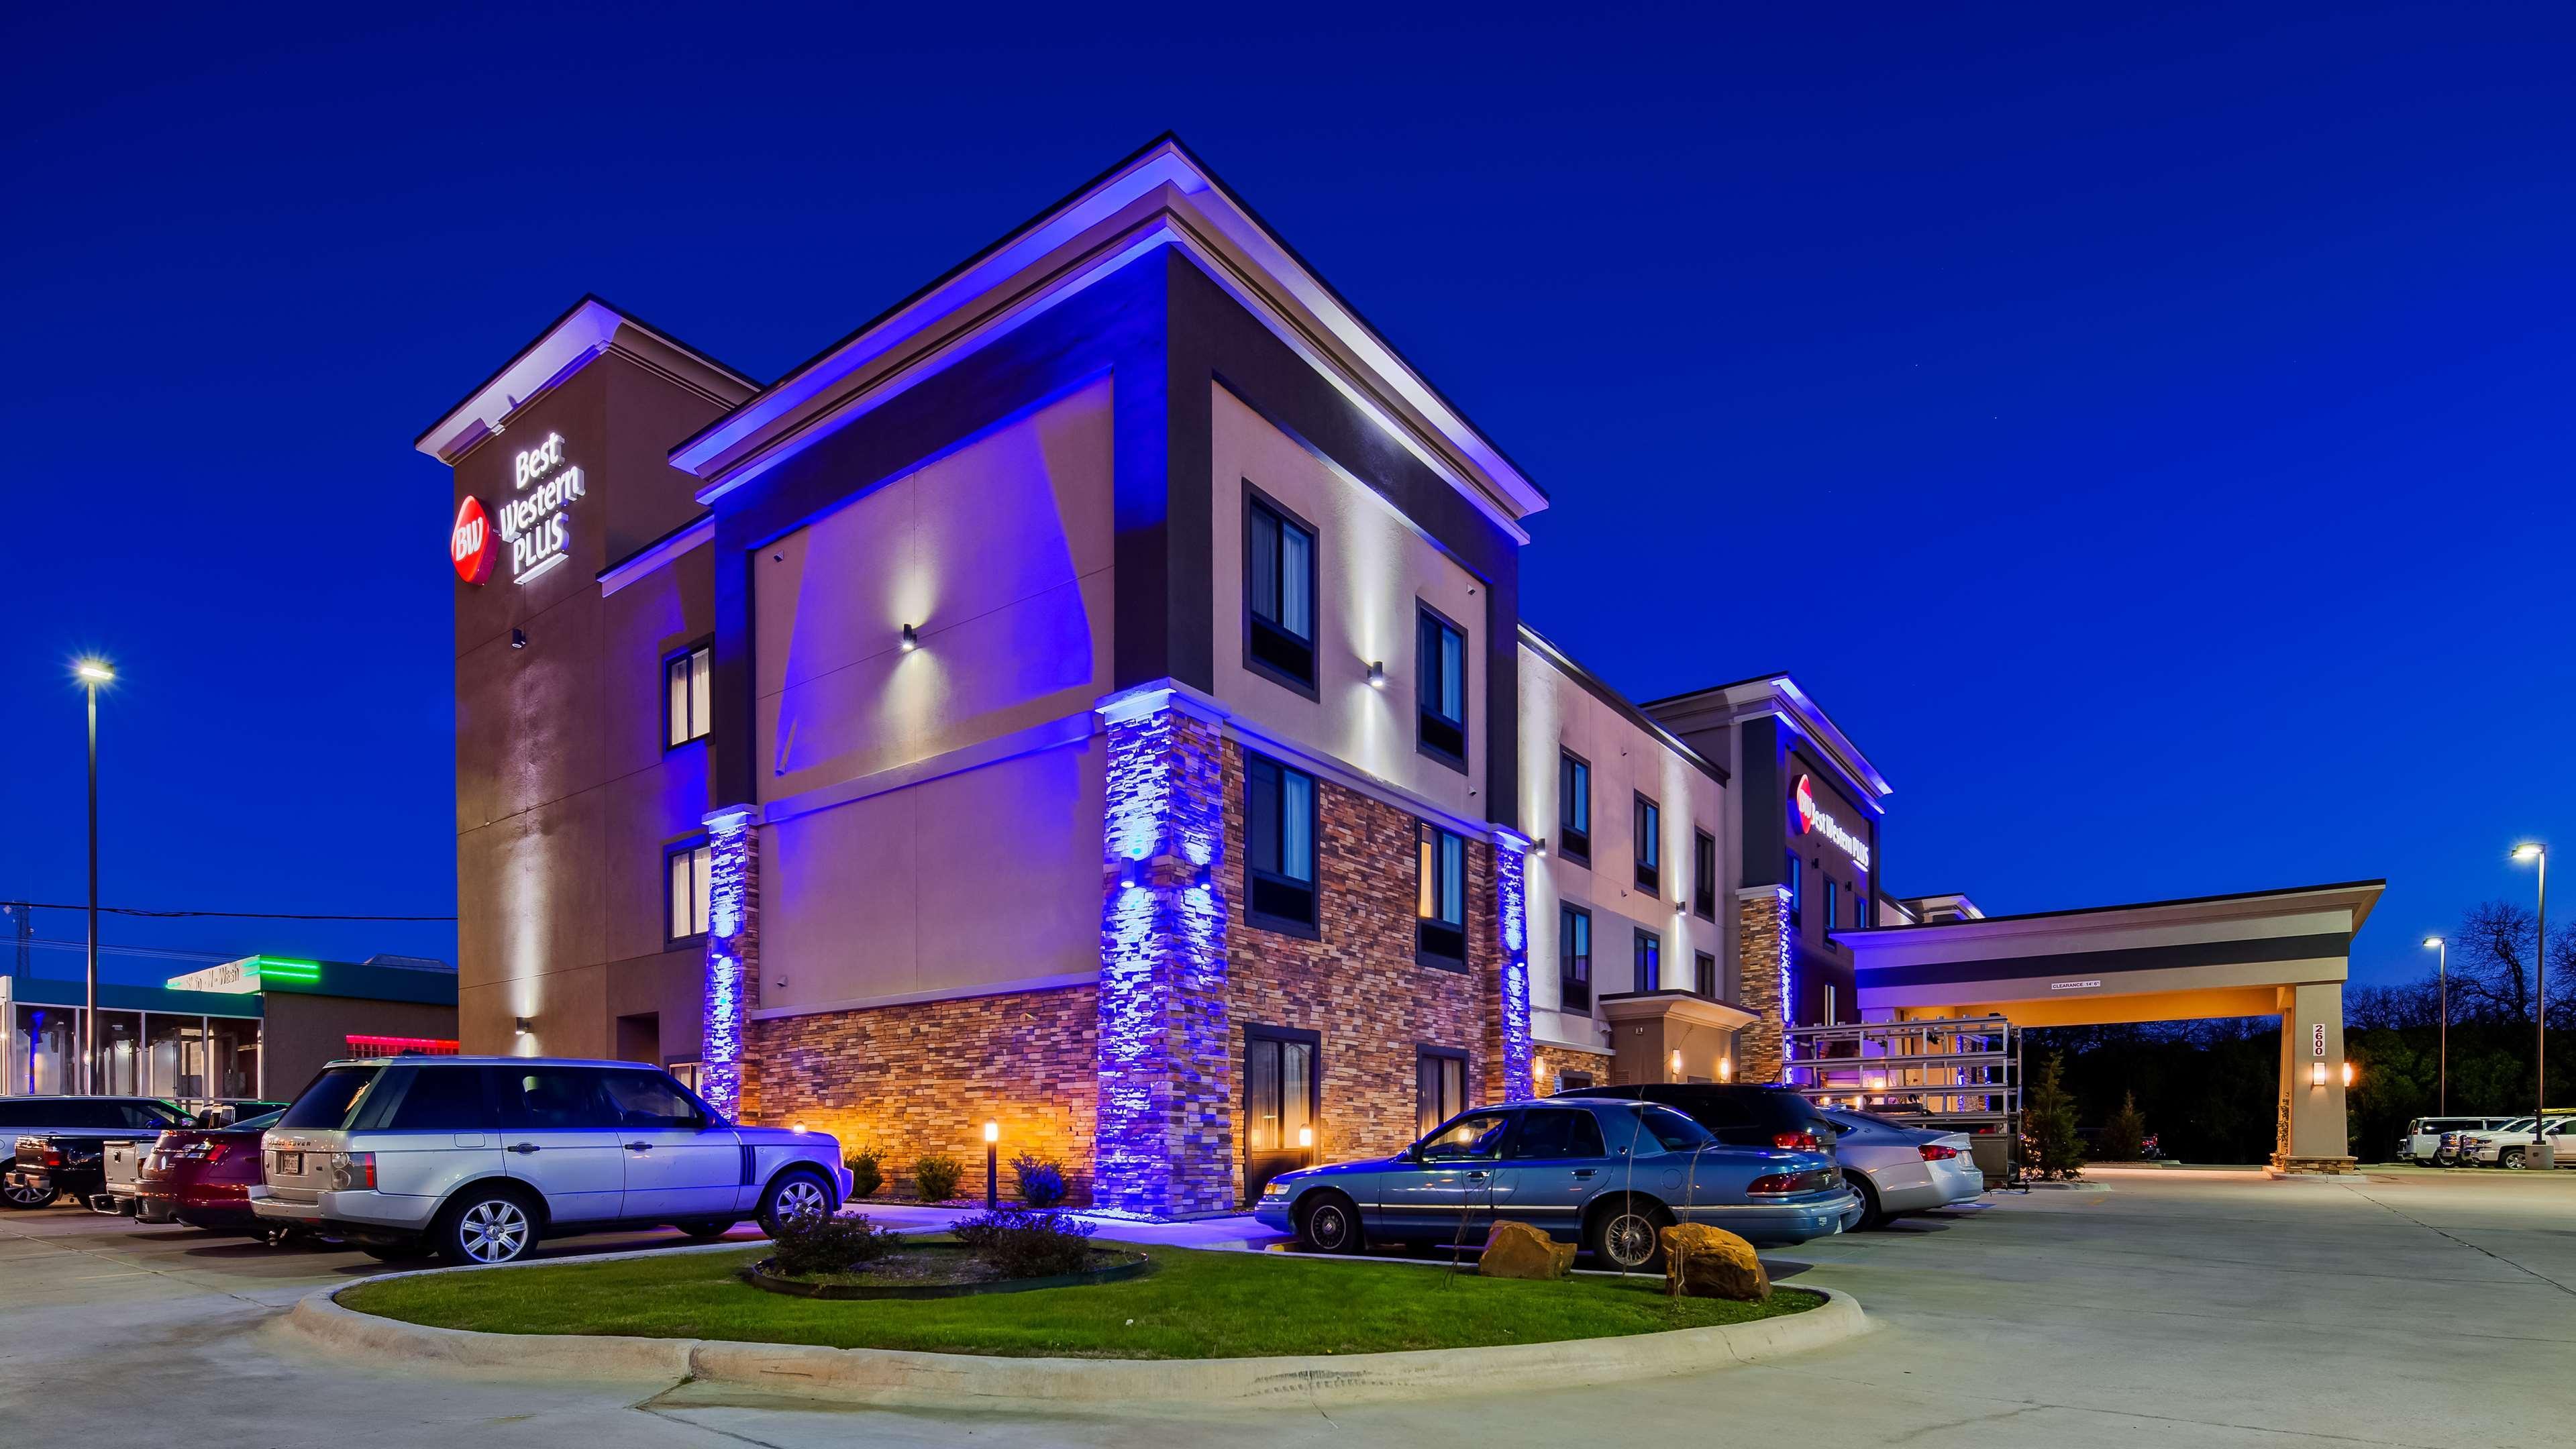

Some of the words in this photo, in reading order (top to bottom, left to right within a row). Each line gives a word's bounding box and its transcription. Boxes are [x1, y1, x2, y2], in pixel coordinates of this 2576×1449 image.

[516, 432, 565, 490] Best
[500, 466, 585, 543] Western
[456, 517, 483, 561] BW
[513, 512, 570, 575] PLUS
[1826, 814, 1853, 854] Western
[1852, 837, 1869, 867] PLUS
[219, 964, 240, 985] Wash
[2315, 1024, 2323, 1055] 2600
